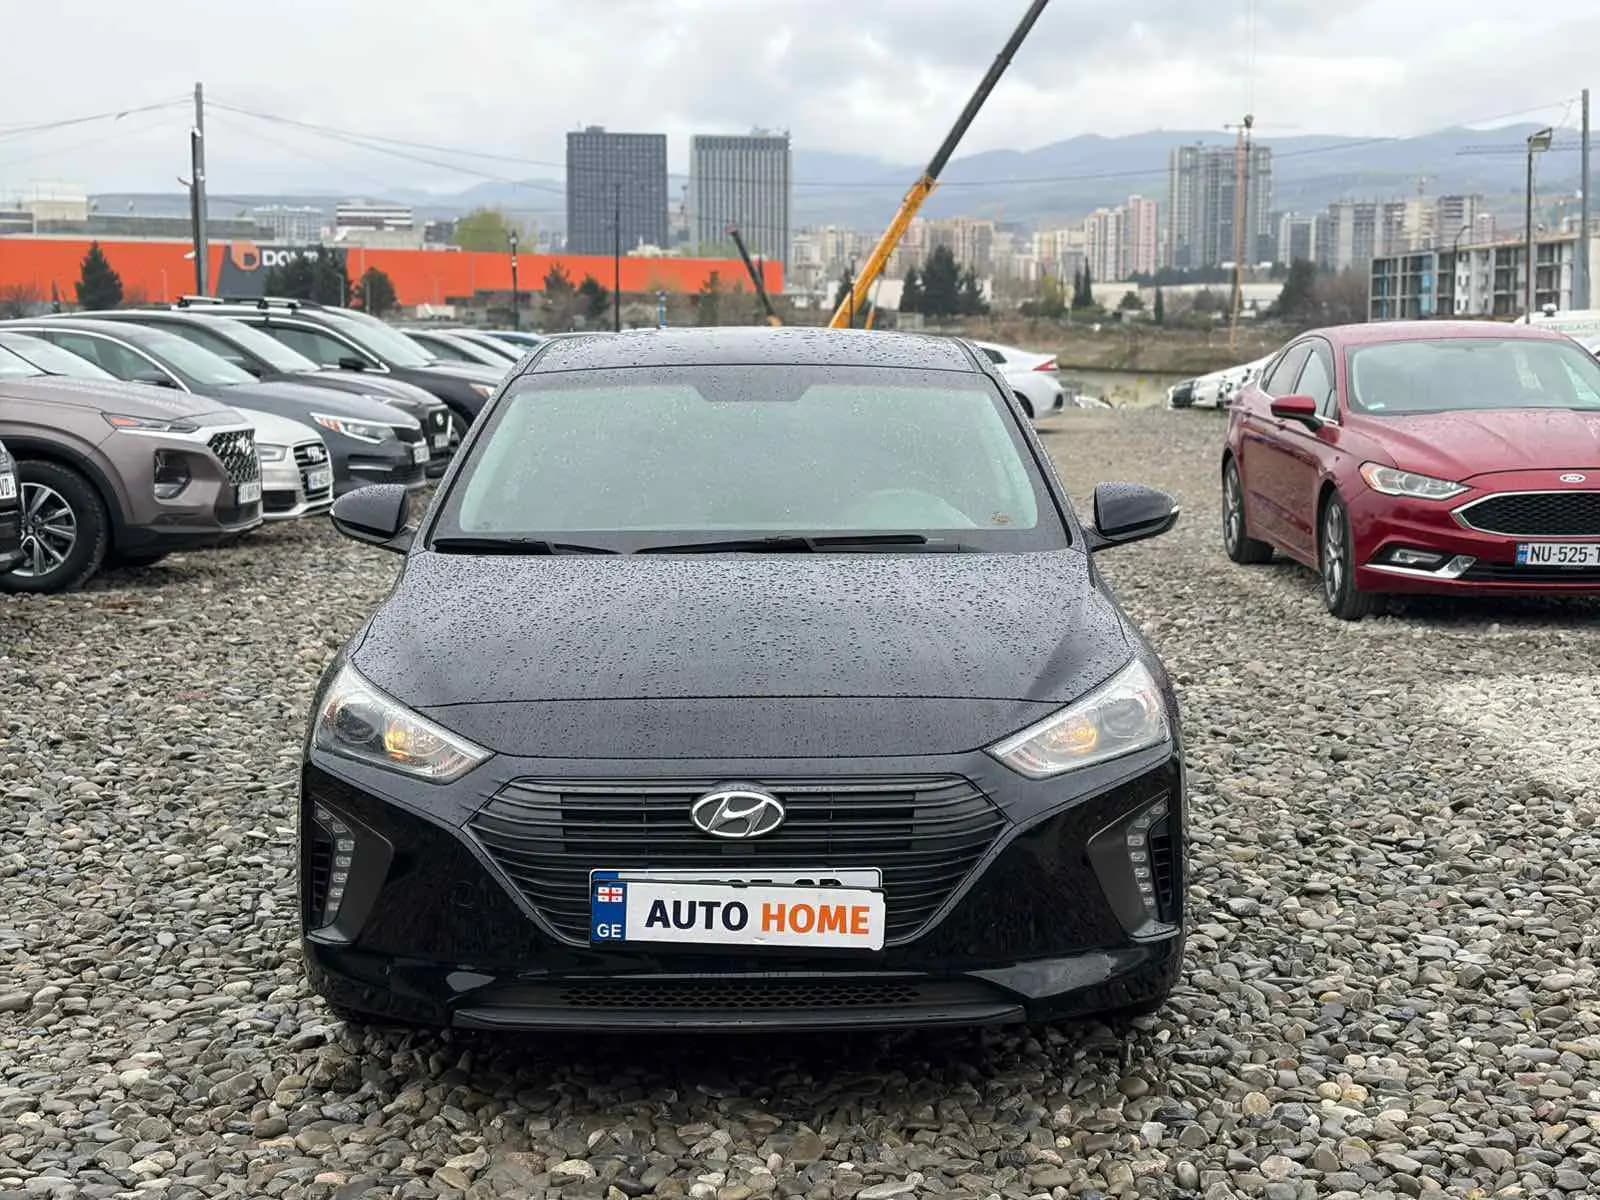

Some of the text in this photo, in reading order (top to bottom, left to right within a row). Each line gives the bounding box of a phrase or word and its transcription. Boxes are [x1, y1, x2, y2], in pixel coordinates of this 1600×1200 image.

[645, 899, 871, 935] AUTO HOME
[597, 923, 622, 938] GE
